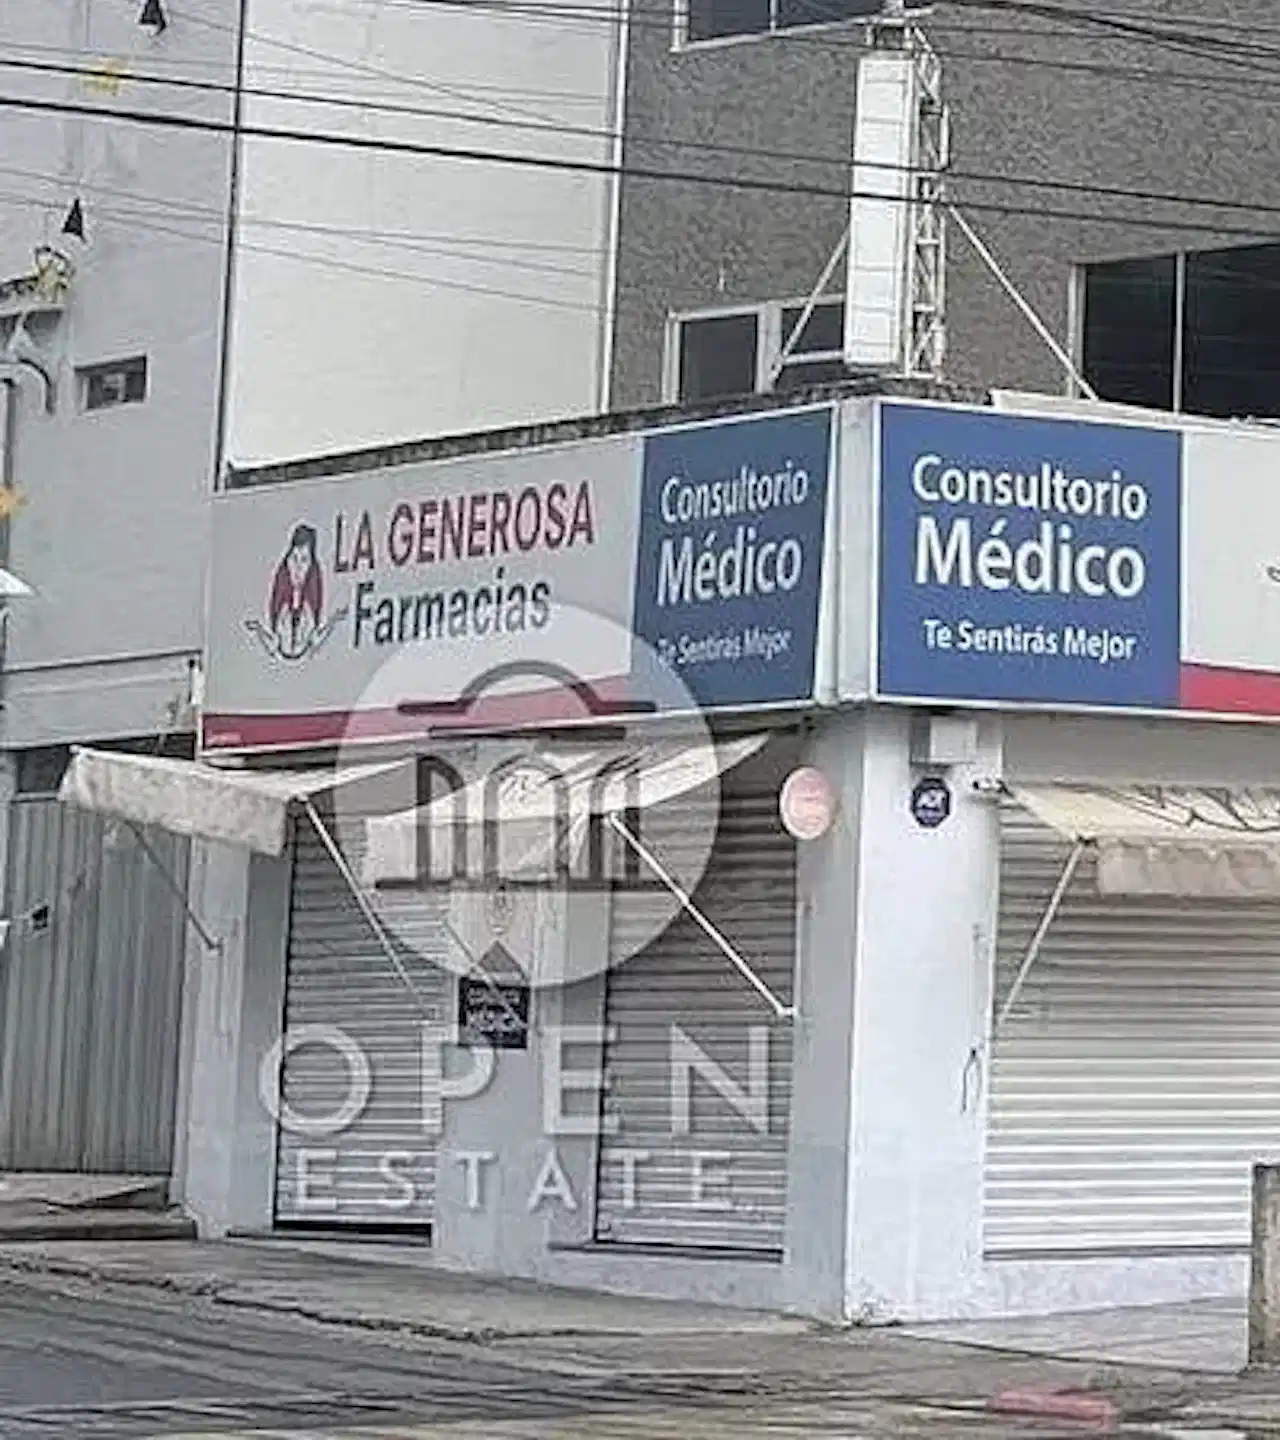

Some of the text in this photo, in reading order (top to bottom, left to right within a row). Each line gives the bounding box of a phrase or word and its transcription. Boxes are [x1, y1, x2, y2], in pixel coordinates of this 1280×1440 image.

[660, 460, 808, 525] Consultorio
[912, 455, 1148, 521] Consultorio
[333, 481, 595, 574] LA GENEROSA
[915, 515, 1145, 598] Médico
[656, 526, 803, 607] Médico
[924, 618, 1137, 665] Te Sentirás Mejor
